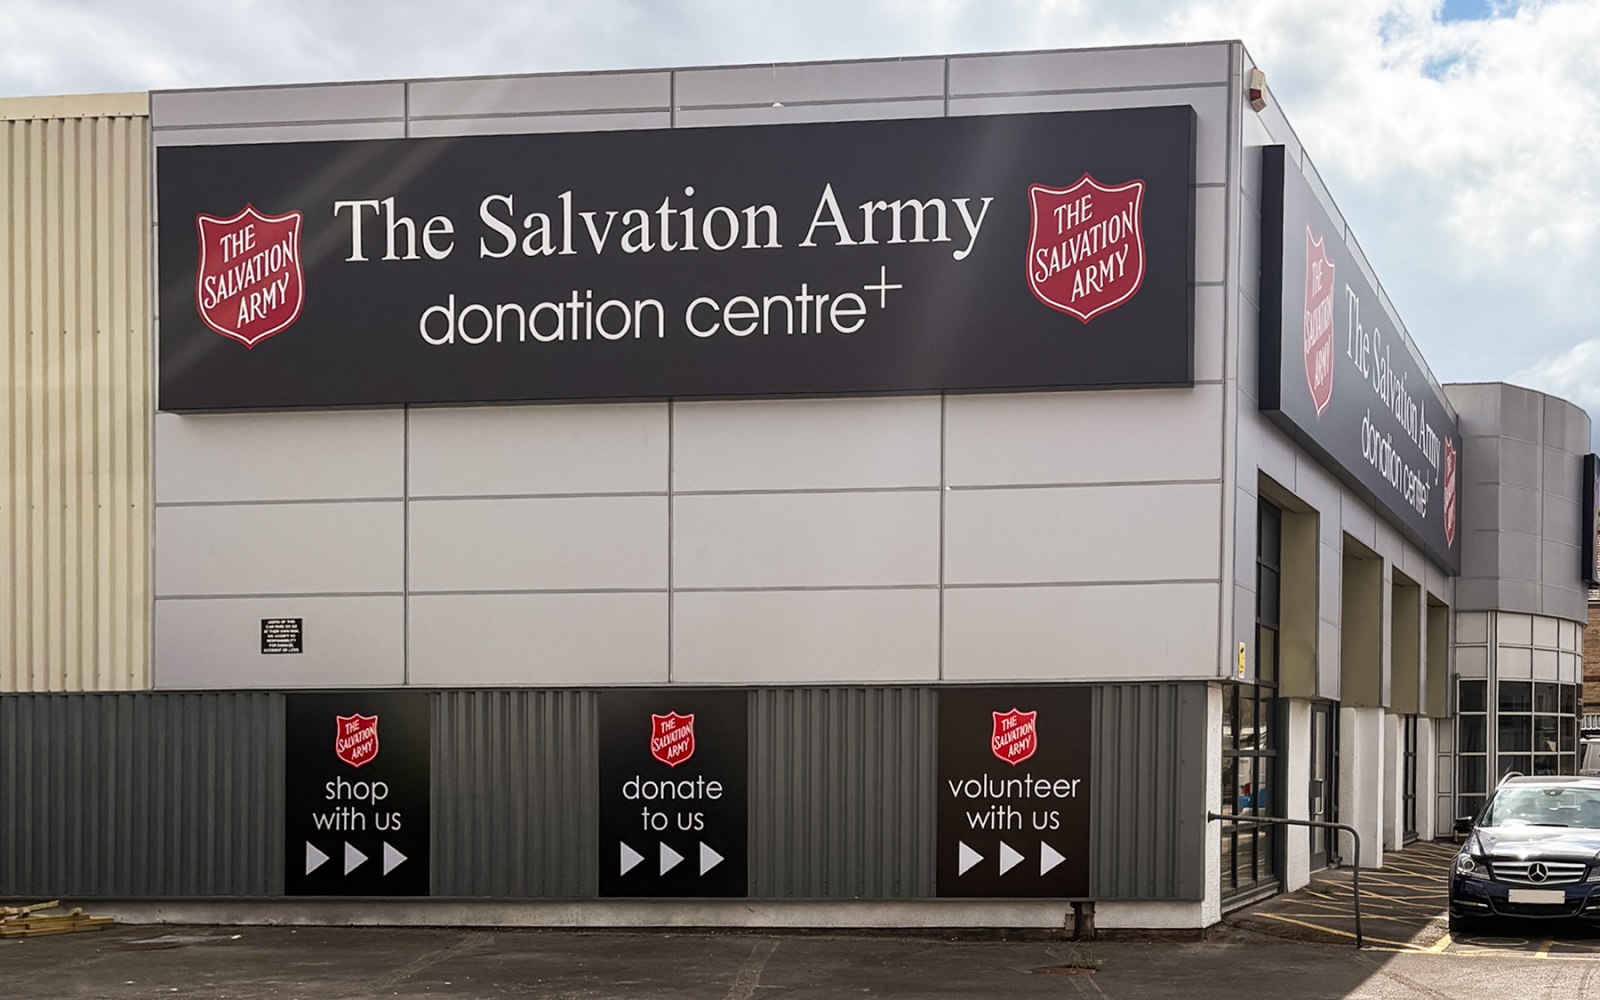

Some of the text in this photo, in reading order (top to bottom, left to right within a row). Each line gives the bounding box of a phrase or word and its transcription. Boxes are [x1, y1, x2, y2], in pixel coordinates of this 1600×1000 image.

[334, 183, 994, 261] The Salvation Army
[1054, 194, 1093, 235] THE
[219, 224, 257, 263] THE
[1035, 201, 1134, 283] SALVATION
[204, 231, 294, 309] SALVATION
[1070, 243, 1129, 303] ARMY
[236, 272, 290, 328] ARMY
[420, 290, 665, 345] donation
[1345, 283, 1441, 486] The Salvation Army
[1361, 408, 1403, 493] donation
[339, 722, 375, 753] SALVATION
[345, 719, 360, 735] THE
[653, 721, 692, 752] SALVATION
[661, 718, 676, 733] THE
[994, 718, 1034, 750] SALVATION
[1001, 715, 1017, 731] THE
[351, 738, 373, 760] ARMY
[667, 737, 690, 759] ARMY
[1008, 735, 1031, 758] ARMY
[326, 776, 389, 805] shop
[622, 775, 723, 800] donate
[948, 773, 1081, 798] volunteer
[313, 806, 401, 831] with us
[641, 806, 704, 831] to us
[966, 805, 1060, 830] with us
